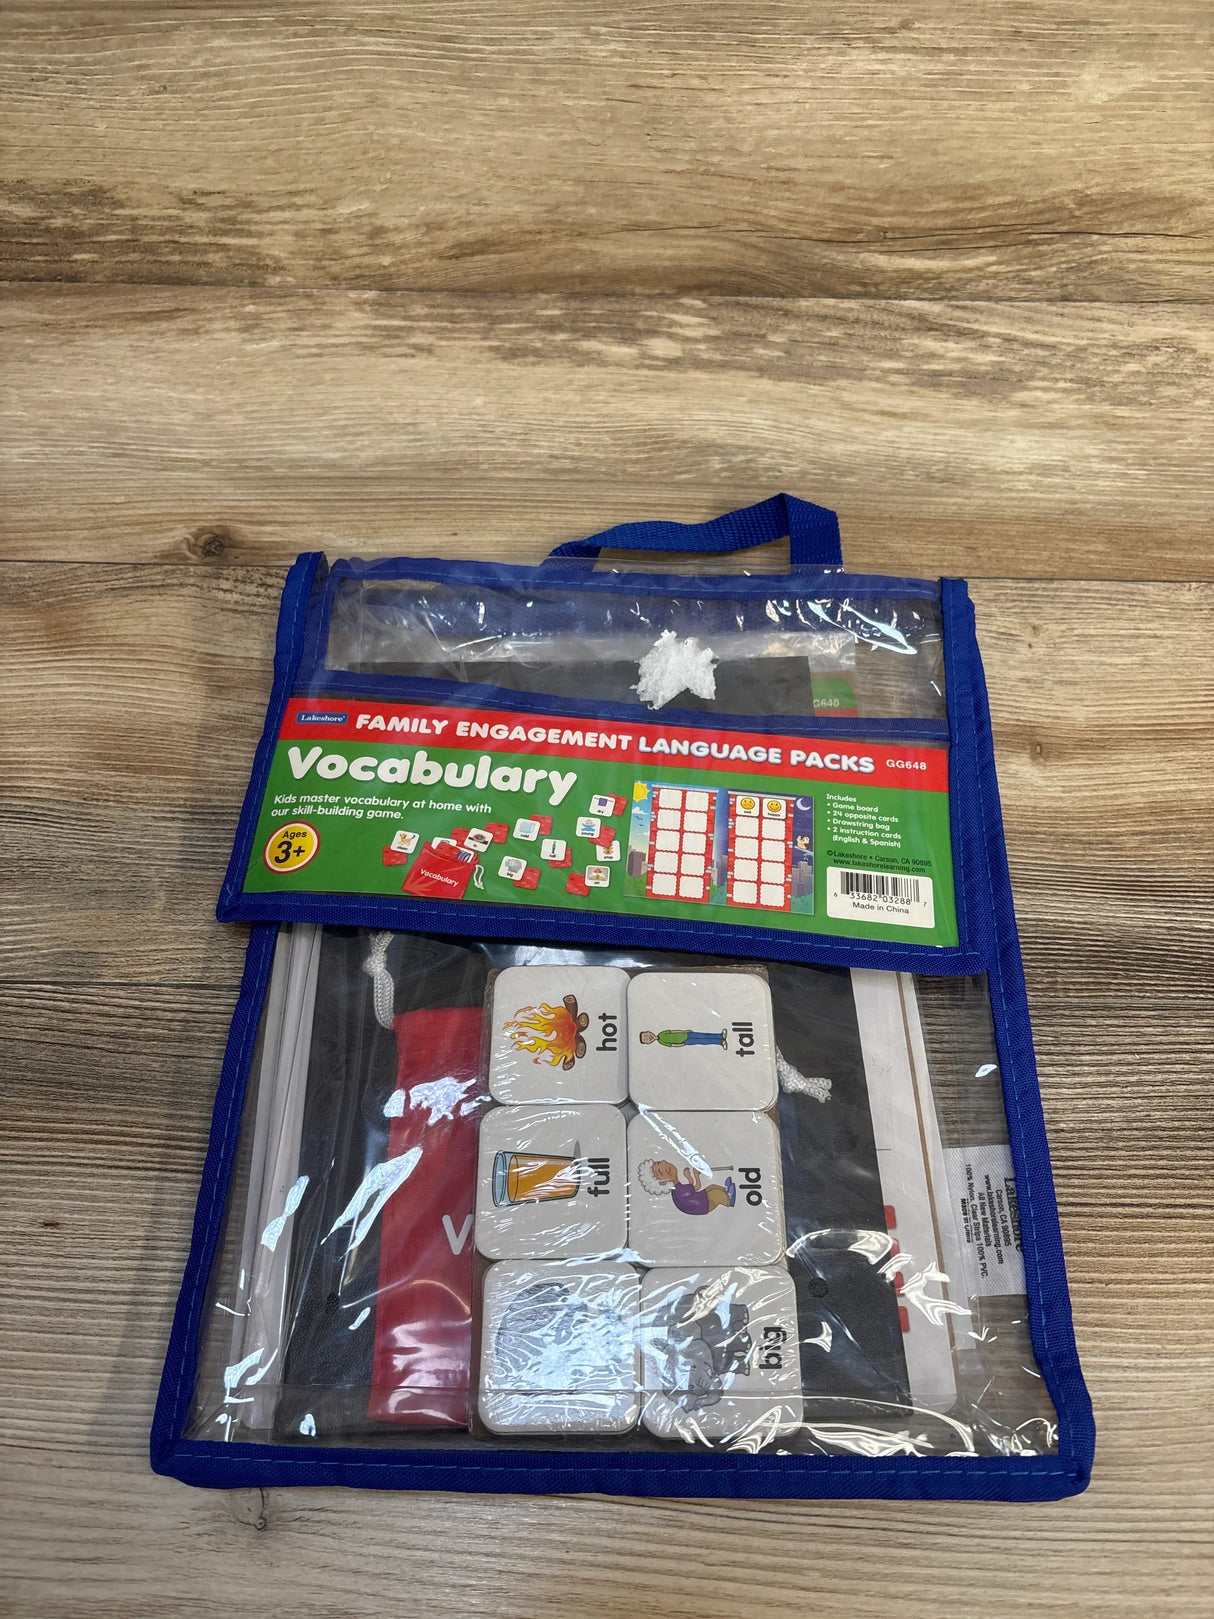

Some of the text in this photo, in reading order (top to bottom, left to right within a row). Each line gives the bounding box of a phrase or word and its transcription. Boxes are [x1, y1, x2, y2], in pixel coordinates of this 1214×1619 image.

[301, 714, 345, 722] Lakeshore
[355, 714, 928, 774] FAMILY ENGAGEMENT LANGUAGE PACKS GG648
[288, 746, 577, 806] Vocabulary
[274, 793, 492, 814] Kids master vocabulary at home with
[826, 793, 857, 802] Includes
[271, 805, 404, 820] our skill-building game.
[832, 802, 879, 813] Game board
[832, 818, 890, 831] Drawstring bag
[845, 812, 877, 821] opposite
[282, 829, 307, 839] Ages
[839, 827, 879, 837] instruction
[832, 835, 860, 844] (English
[869, 839, 901, 848] Spanish)
[274, 840, 306, 864] 3+
[833, 858, 926, 873] www.lakeshorelearning.com
[420, 868, 459, 887] Vocabulary
[852, 902, 875, 911] Made
[886, 905, 909, 914] China
[882, 896, 911, 905] 03288
[596, 1012, 617, 1051] hot
[731, 1021, 755, 1057] tall
[587, 1157, 610, 1197] full
[965, 1164, 973, 1181] 100%
[738, 1167, 763, 1206] old
[970, 1203, 979, 1221] Clear
[979, 1202, 987, 1216] New
[984, 1175, 1005, 1264] www.lakeshorelearning.com
[1000, 1214, 1007, 1224] CA
[972, 1222, 982, 1241] Strips
[981, 1217, 992, 1247] Materials
[976, 1243, 985, 1261] 100%
[980, 1262, 988, 1279] PVC.
[759, 1326, 787, 1369] big
